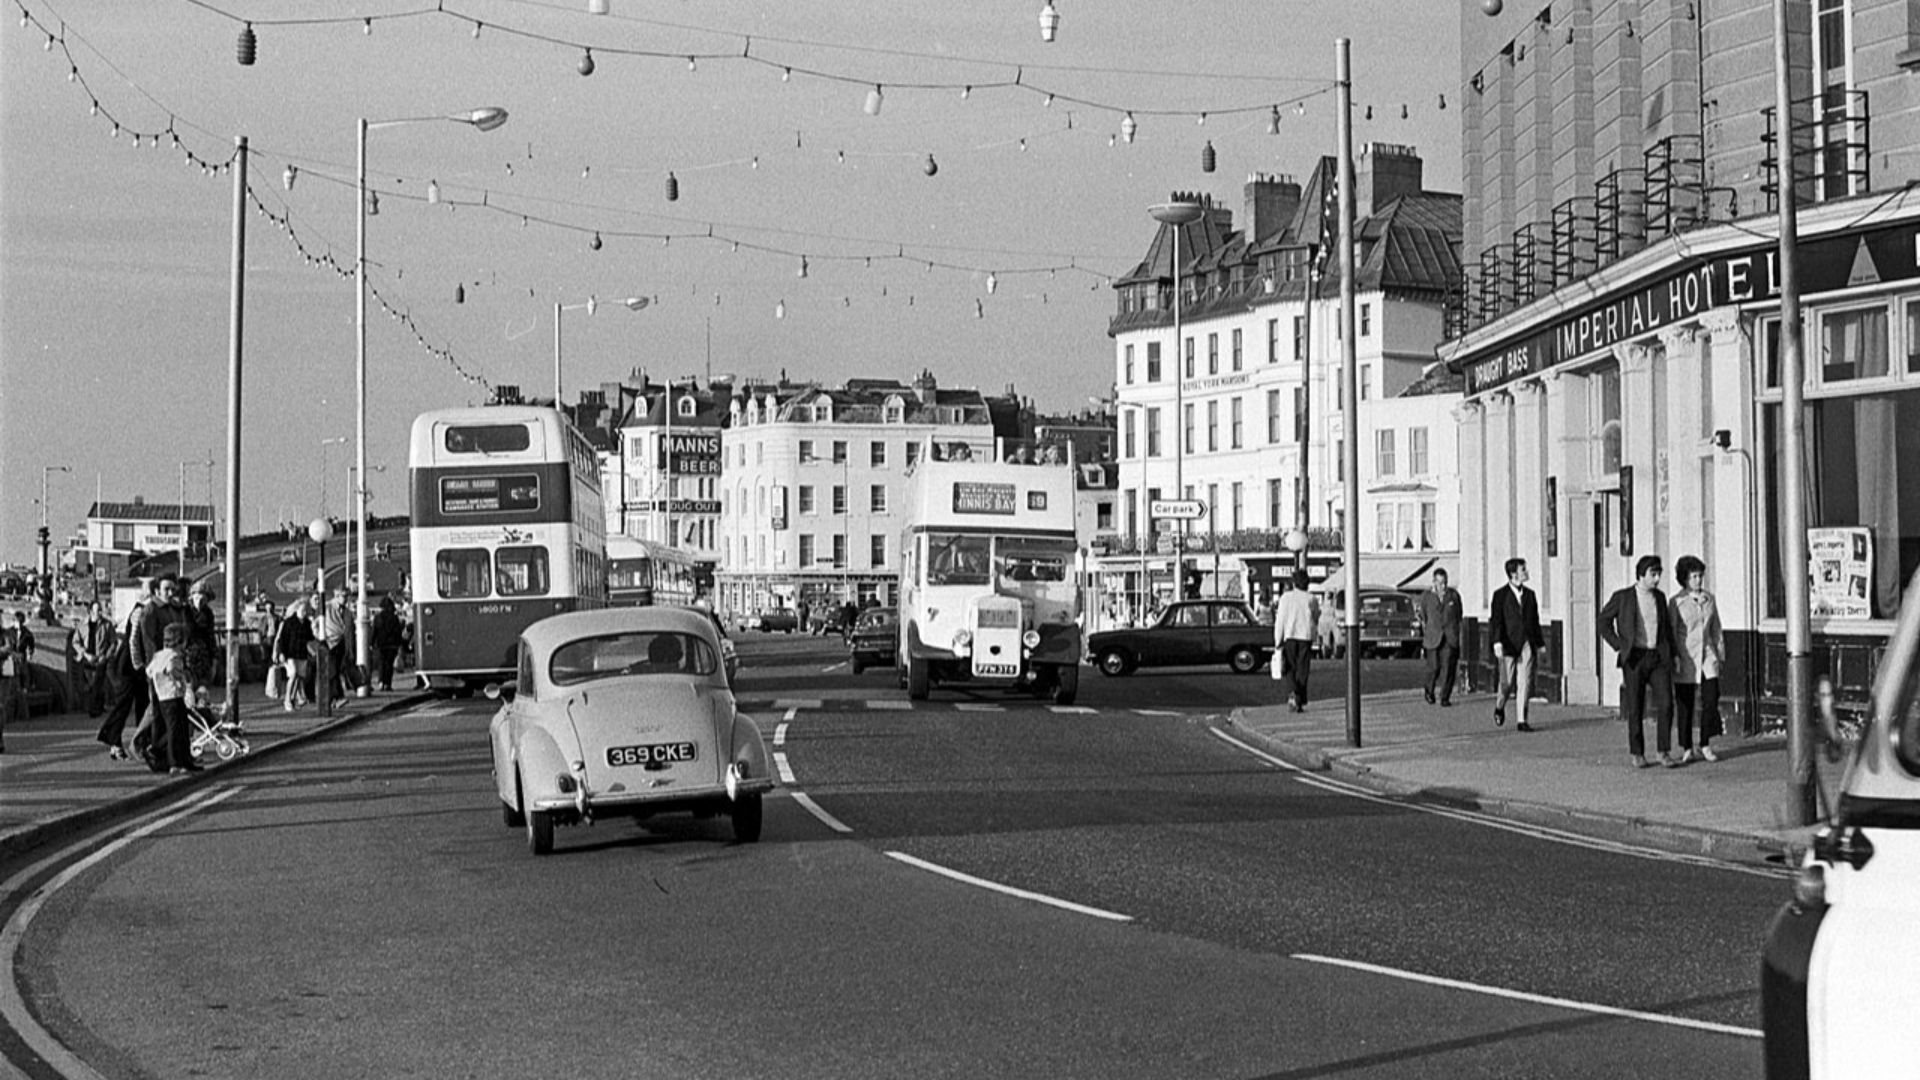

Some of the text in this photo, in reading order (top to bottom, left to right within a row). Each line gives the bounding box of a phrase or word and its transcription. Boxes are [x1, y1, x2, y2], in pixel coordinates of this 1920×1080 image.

[1556, 252, 1781, 361] IMPERIAL HOTEL
[1507, 346, 1528, 375] BASS
[662, 437, 719, 454] MANNS
[680, 460, 718, 472] BEER
[696, 501, 717, 511] OUT
[995, 500, 1015, 510] BAY
[1155, 503, 1193, 514] Car park
[611, 743, 692, 764] 369 CKE
